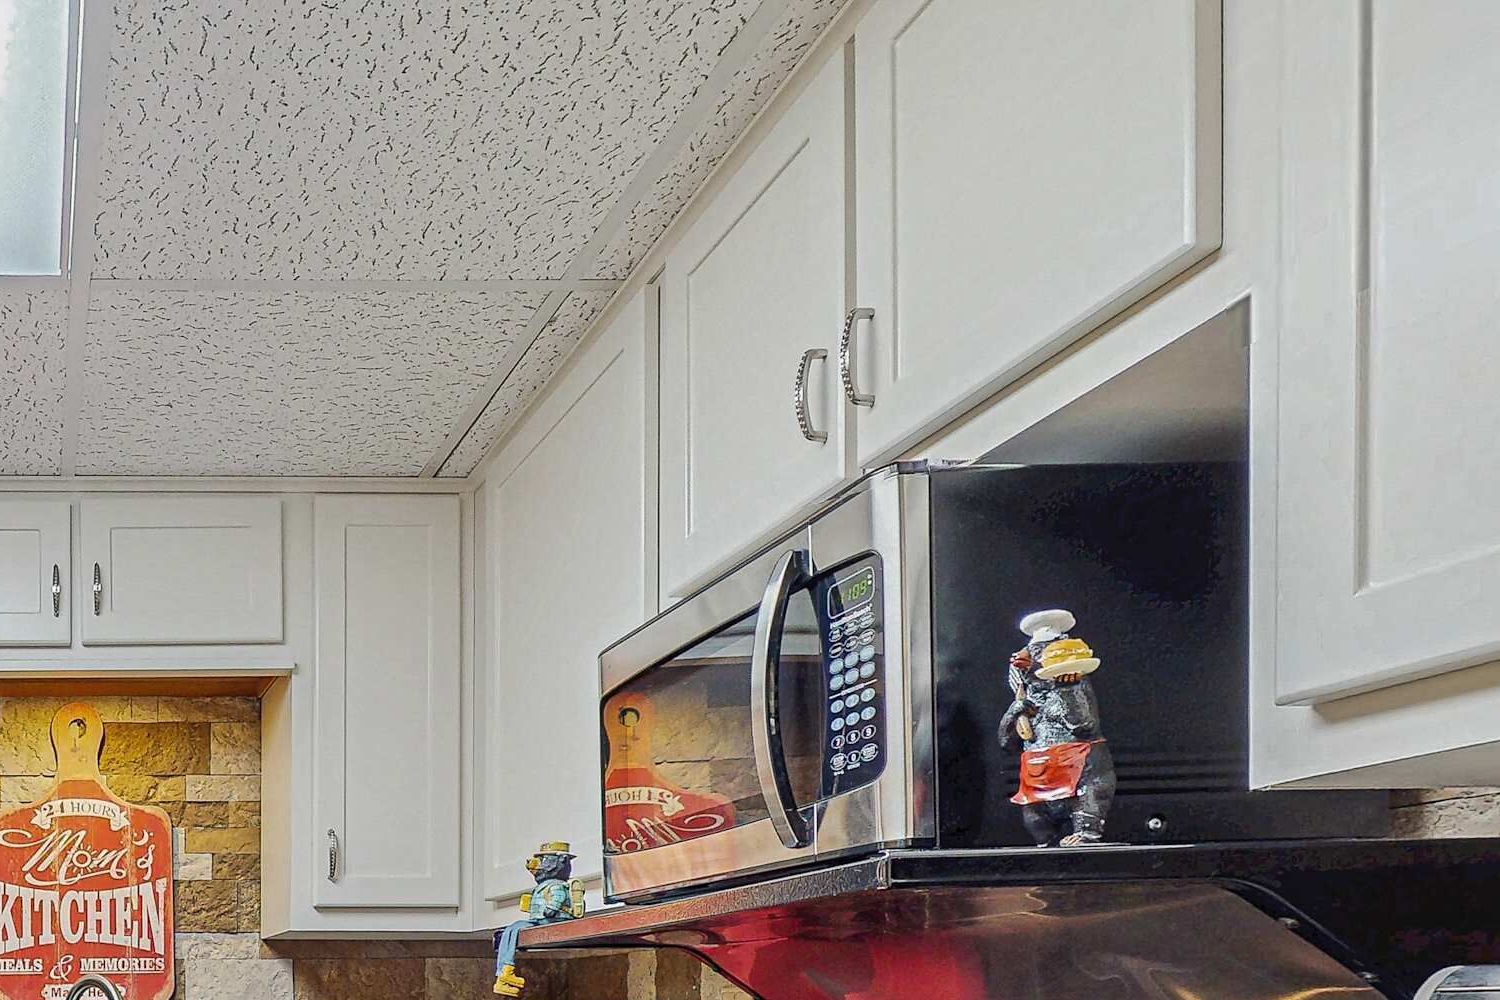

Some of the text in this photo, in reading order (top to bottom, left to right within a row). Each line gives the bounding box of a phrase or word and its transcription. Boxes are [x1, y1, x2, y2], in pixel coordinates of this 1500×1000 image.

[41, 802, 117, 818] 24 HOURS
[50, 955, 74, 981] &
[80, 957, 165, 973] MEMORIES
